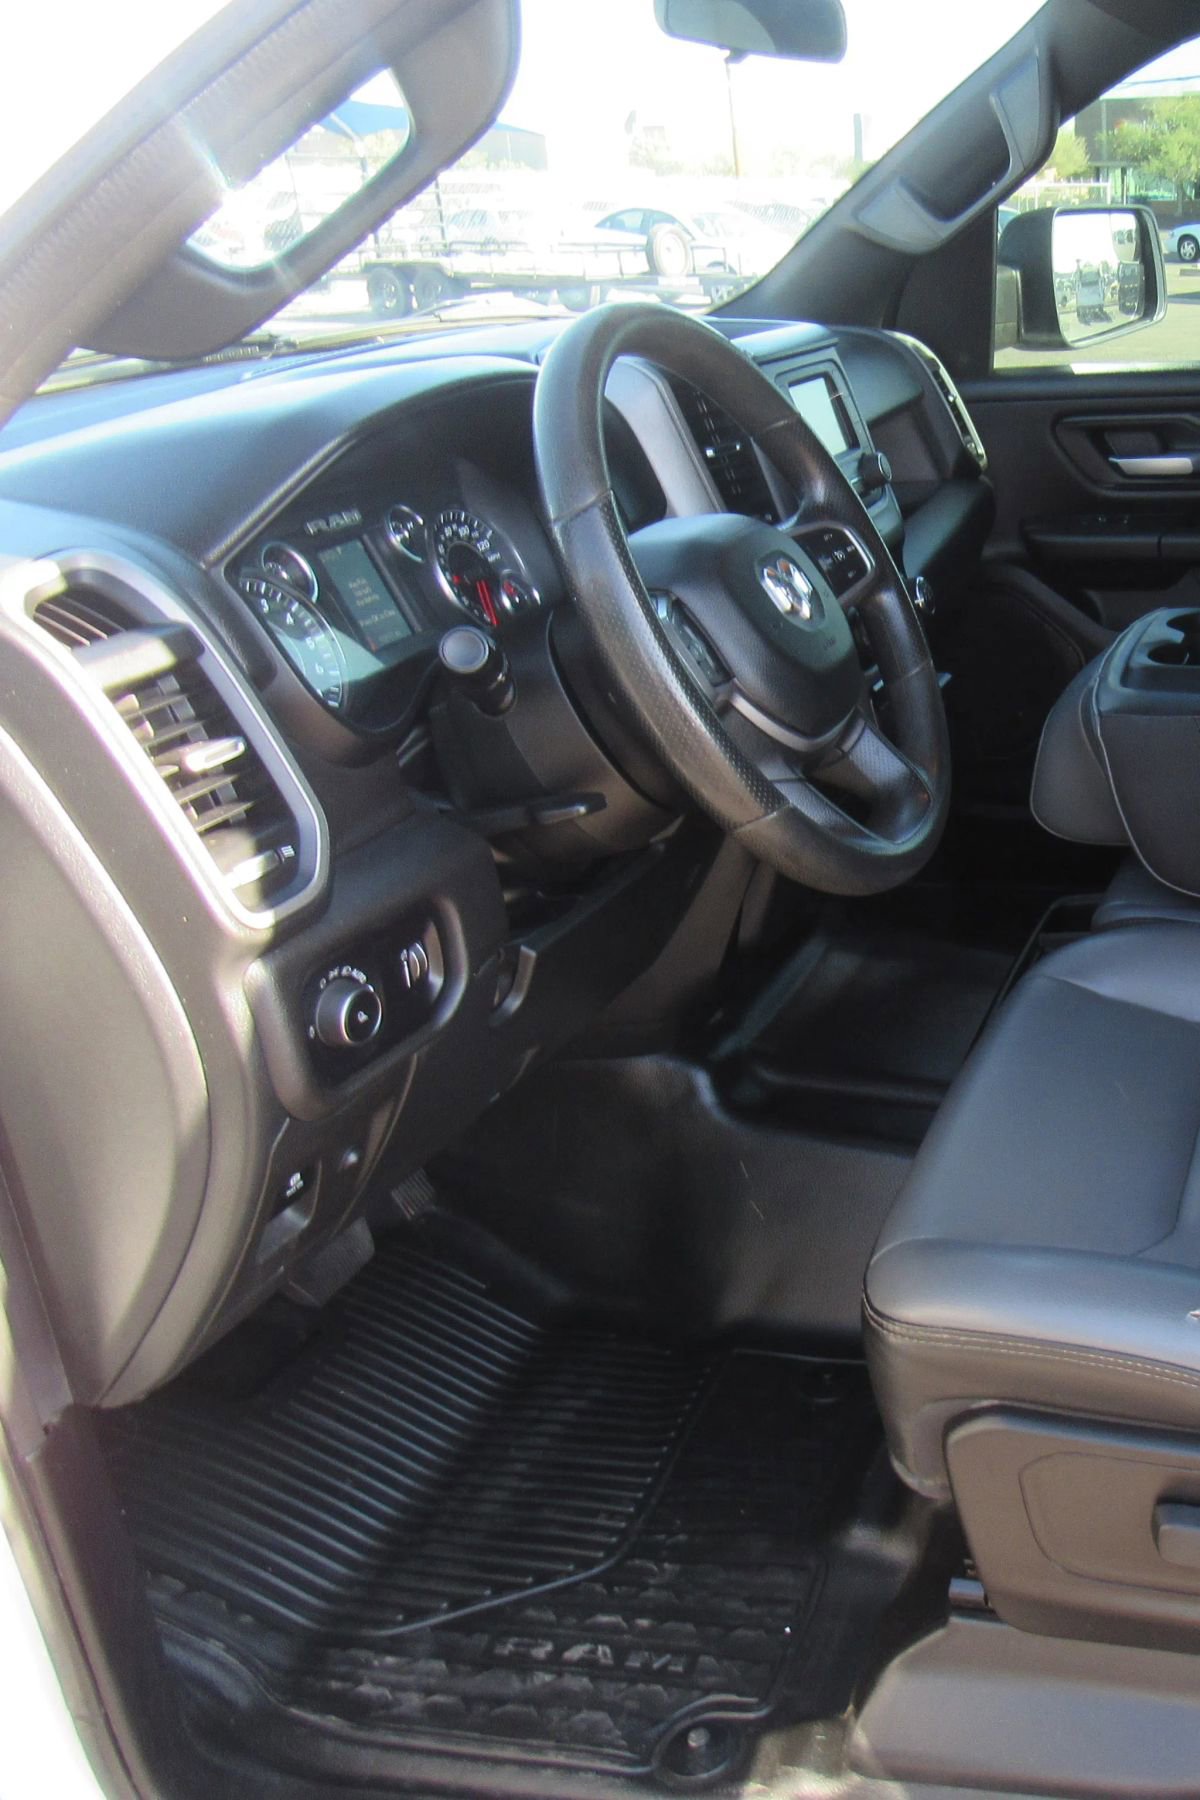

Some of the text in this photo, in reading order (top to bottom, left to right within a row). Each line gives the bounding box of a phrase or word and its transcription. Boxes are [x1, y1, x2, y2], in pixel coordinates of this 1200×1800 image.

[304, 509, 362, 536] RAM
[477, 539, 491, 552] 120
[315, 662, 325, 676] 6
[494, 1636, 685, 1674] RAM
